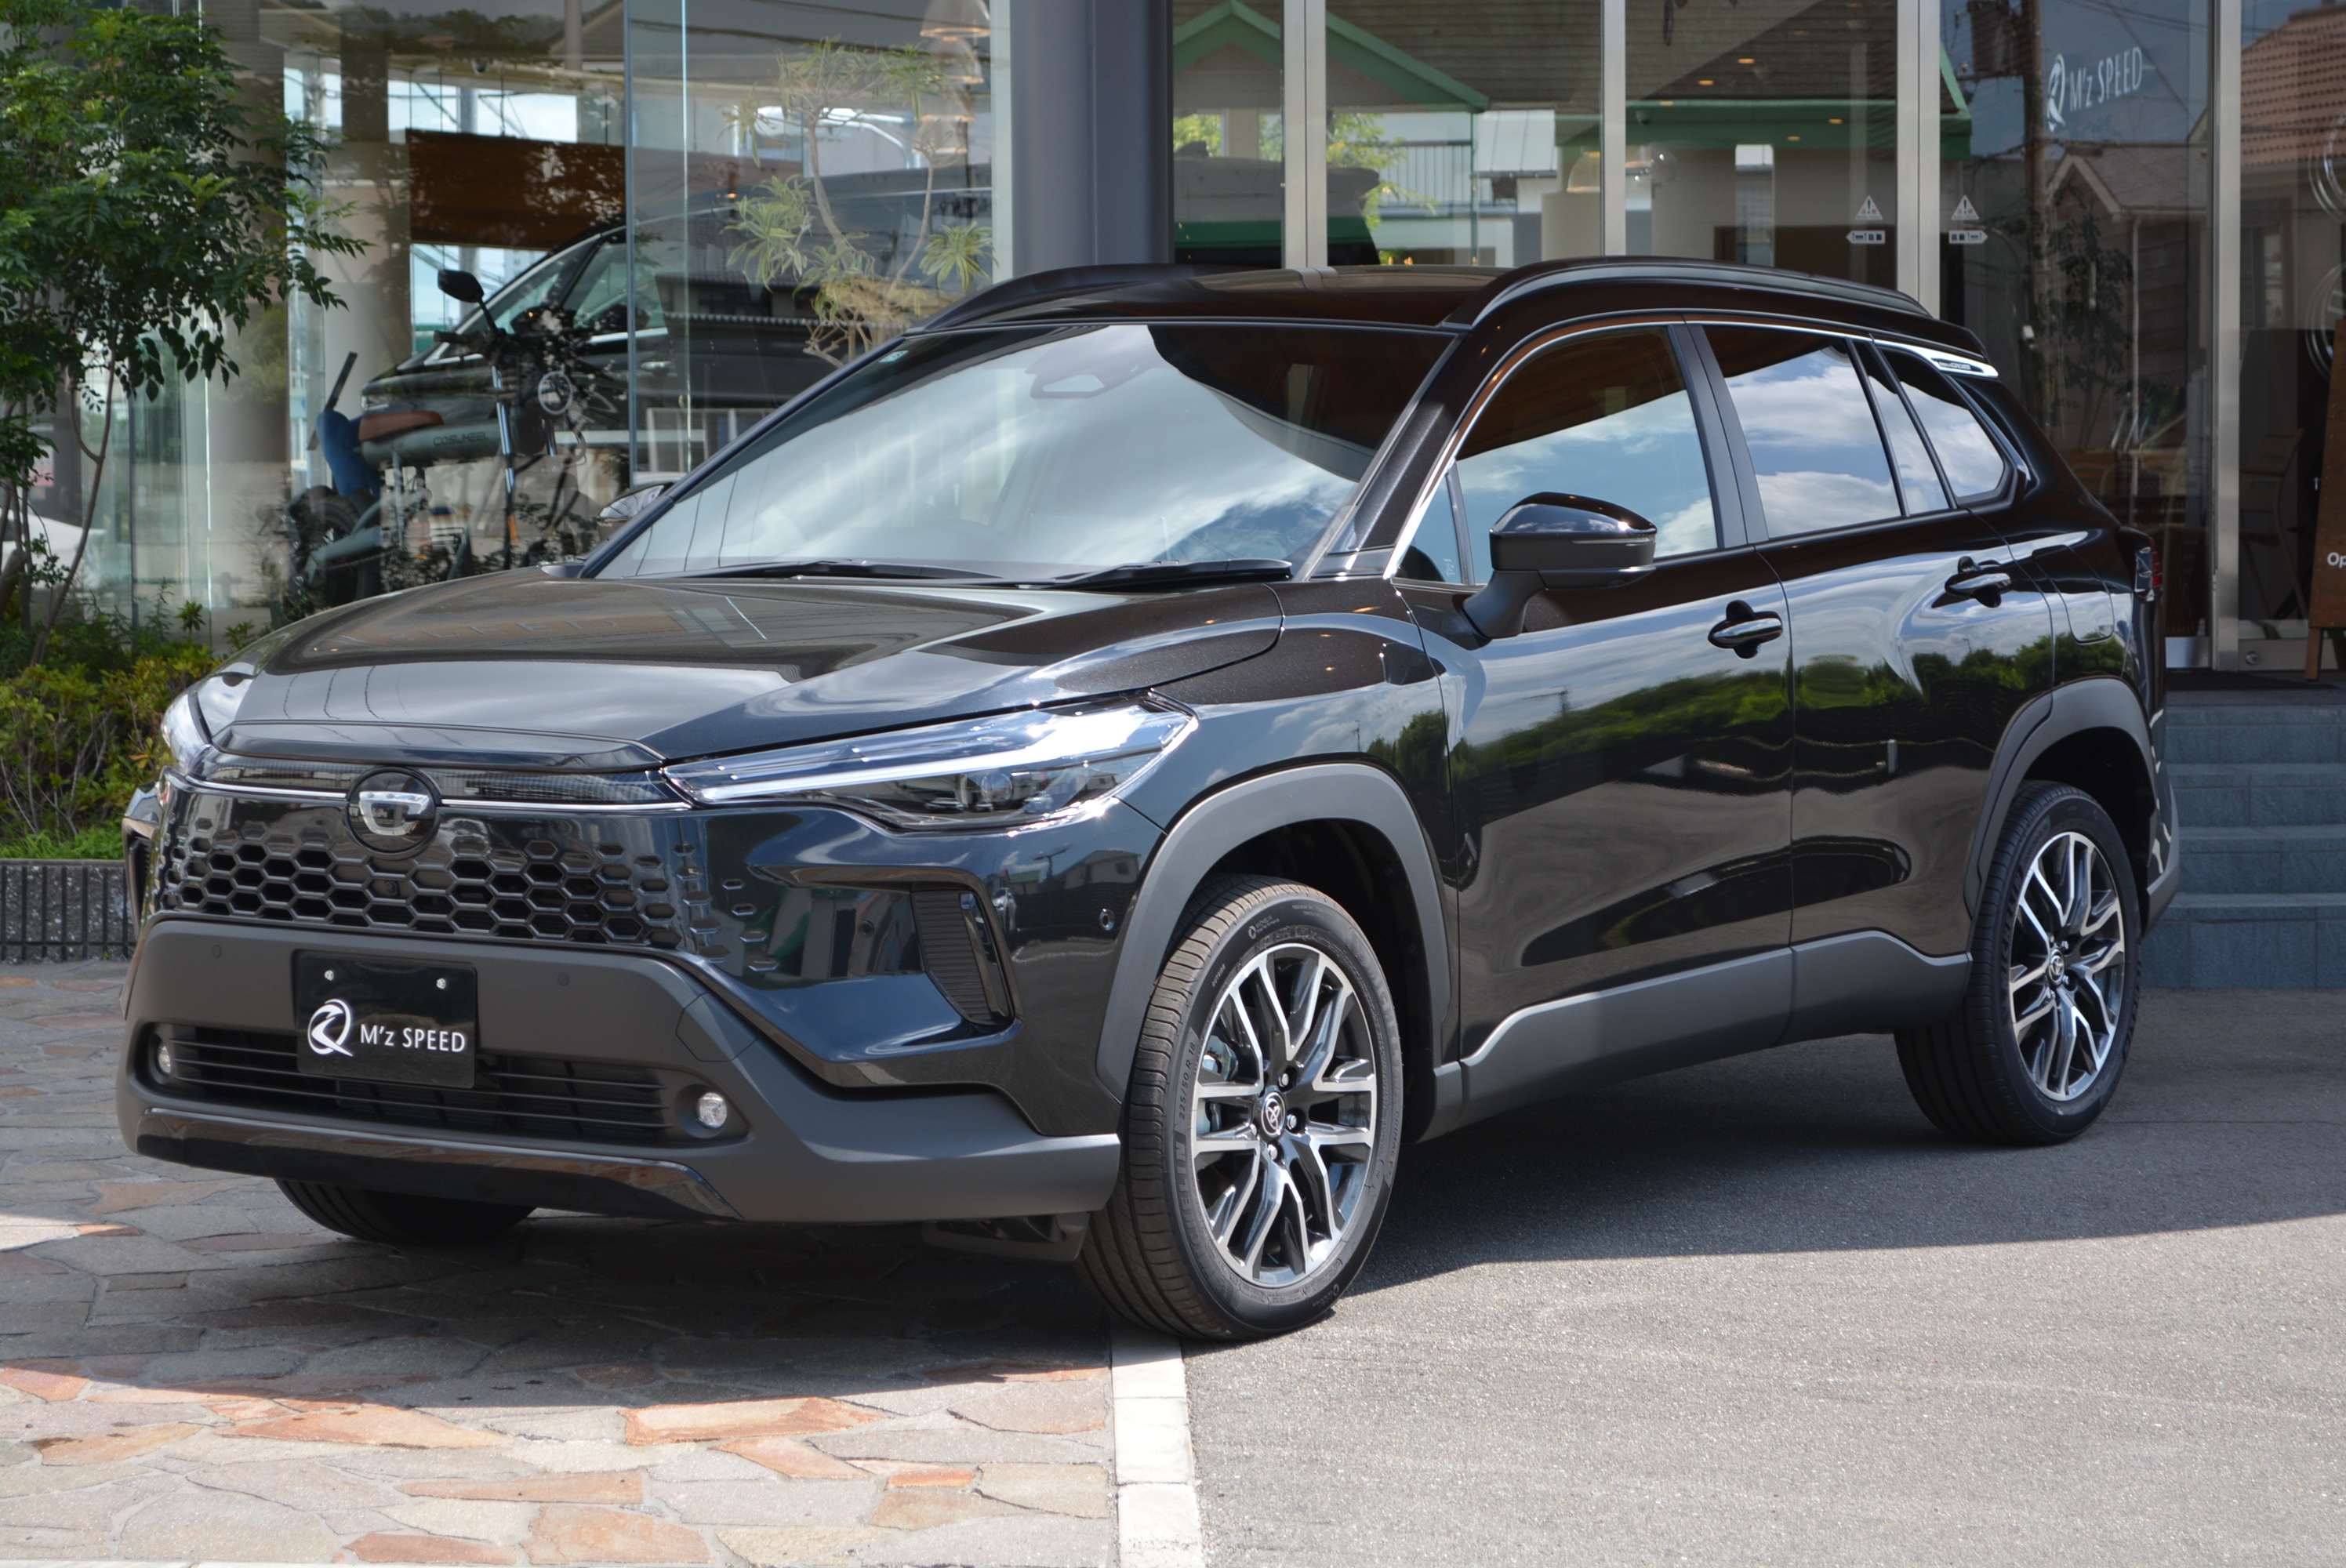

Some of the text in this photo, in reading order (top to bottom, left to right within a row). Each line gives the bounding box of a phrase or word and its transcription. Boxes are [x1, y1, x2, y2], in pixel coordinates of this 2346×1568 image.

[2069, 45, 2143, 112] M'z SPEED
[433, 431, 489, 446] COSWHEEL
[360, 1024, 465, 1053] M'z SPEED
[1178, 1041, 1196, 1120] 225/50 R 18
[1175, 1140, 1217, 1282] MICHELIN
